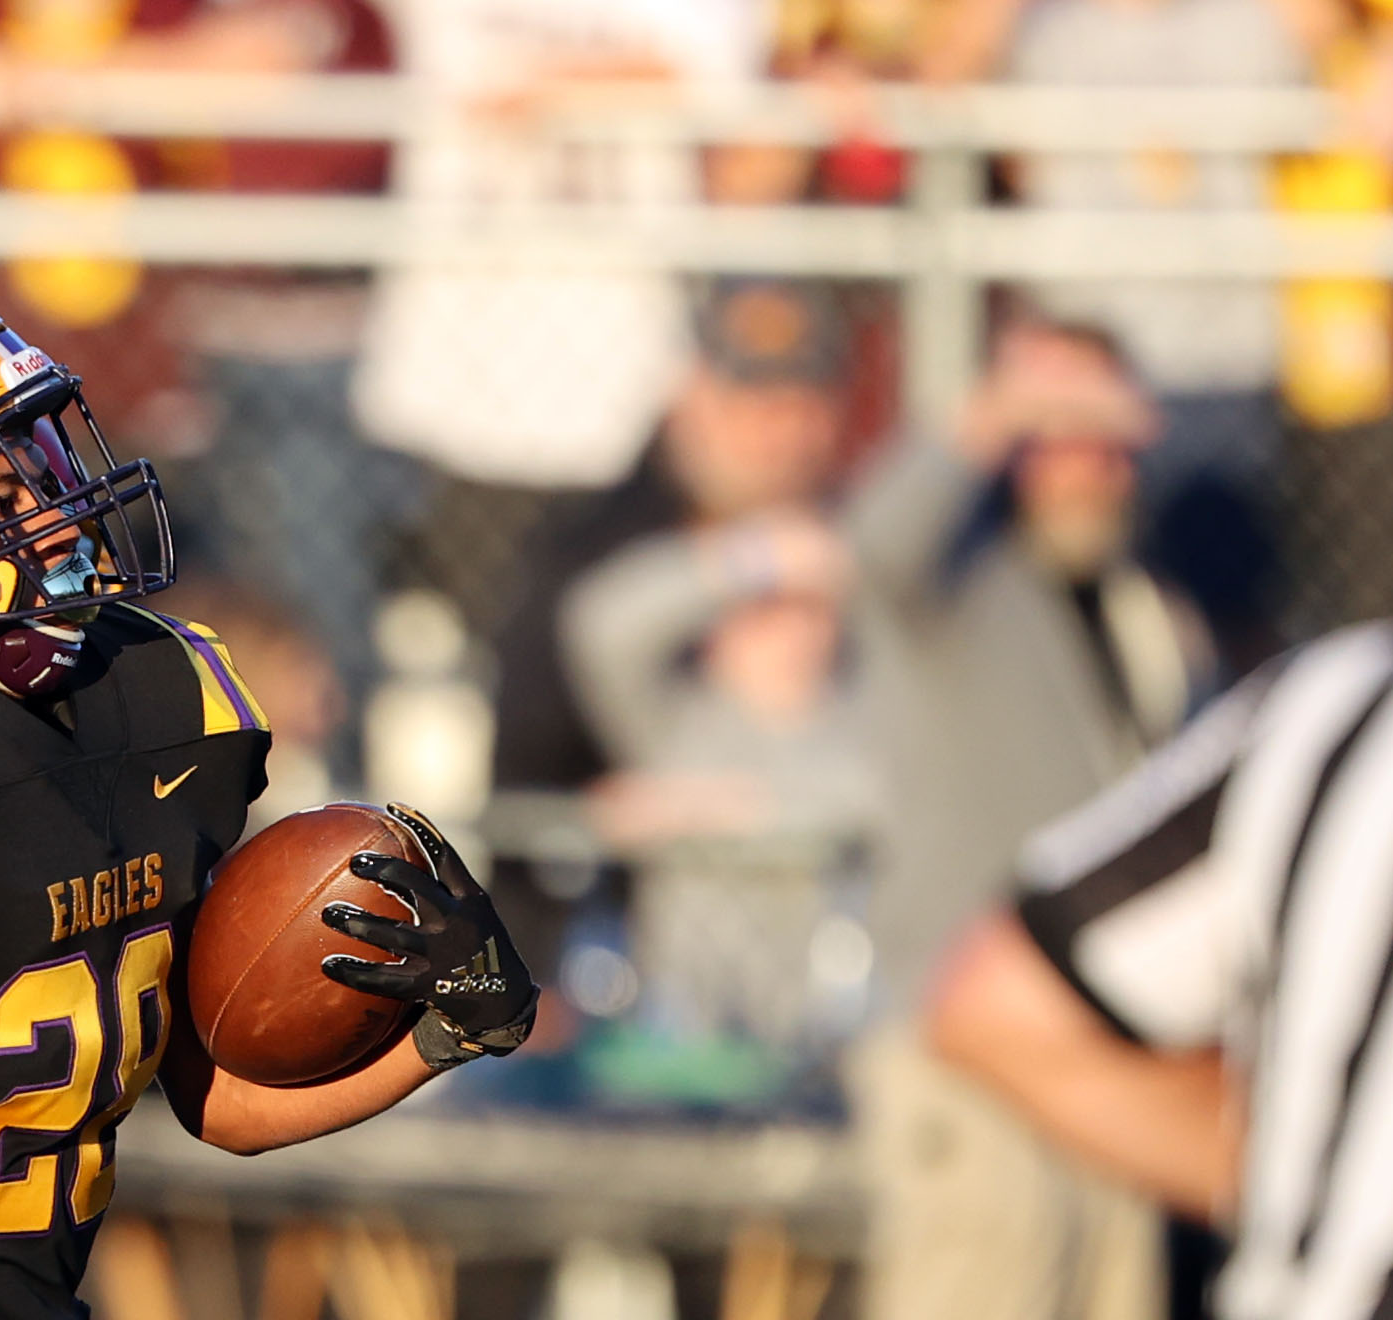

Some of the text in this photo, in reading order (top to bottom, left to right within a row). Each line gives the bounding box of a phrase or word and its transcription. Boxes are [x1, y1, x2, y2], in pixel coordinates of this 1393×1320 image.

[12, 352, 45, 377] Ridd
[46, 852, 163, 942] EAGLES
[435, 973, 507, 995] adidas
